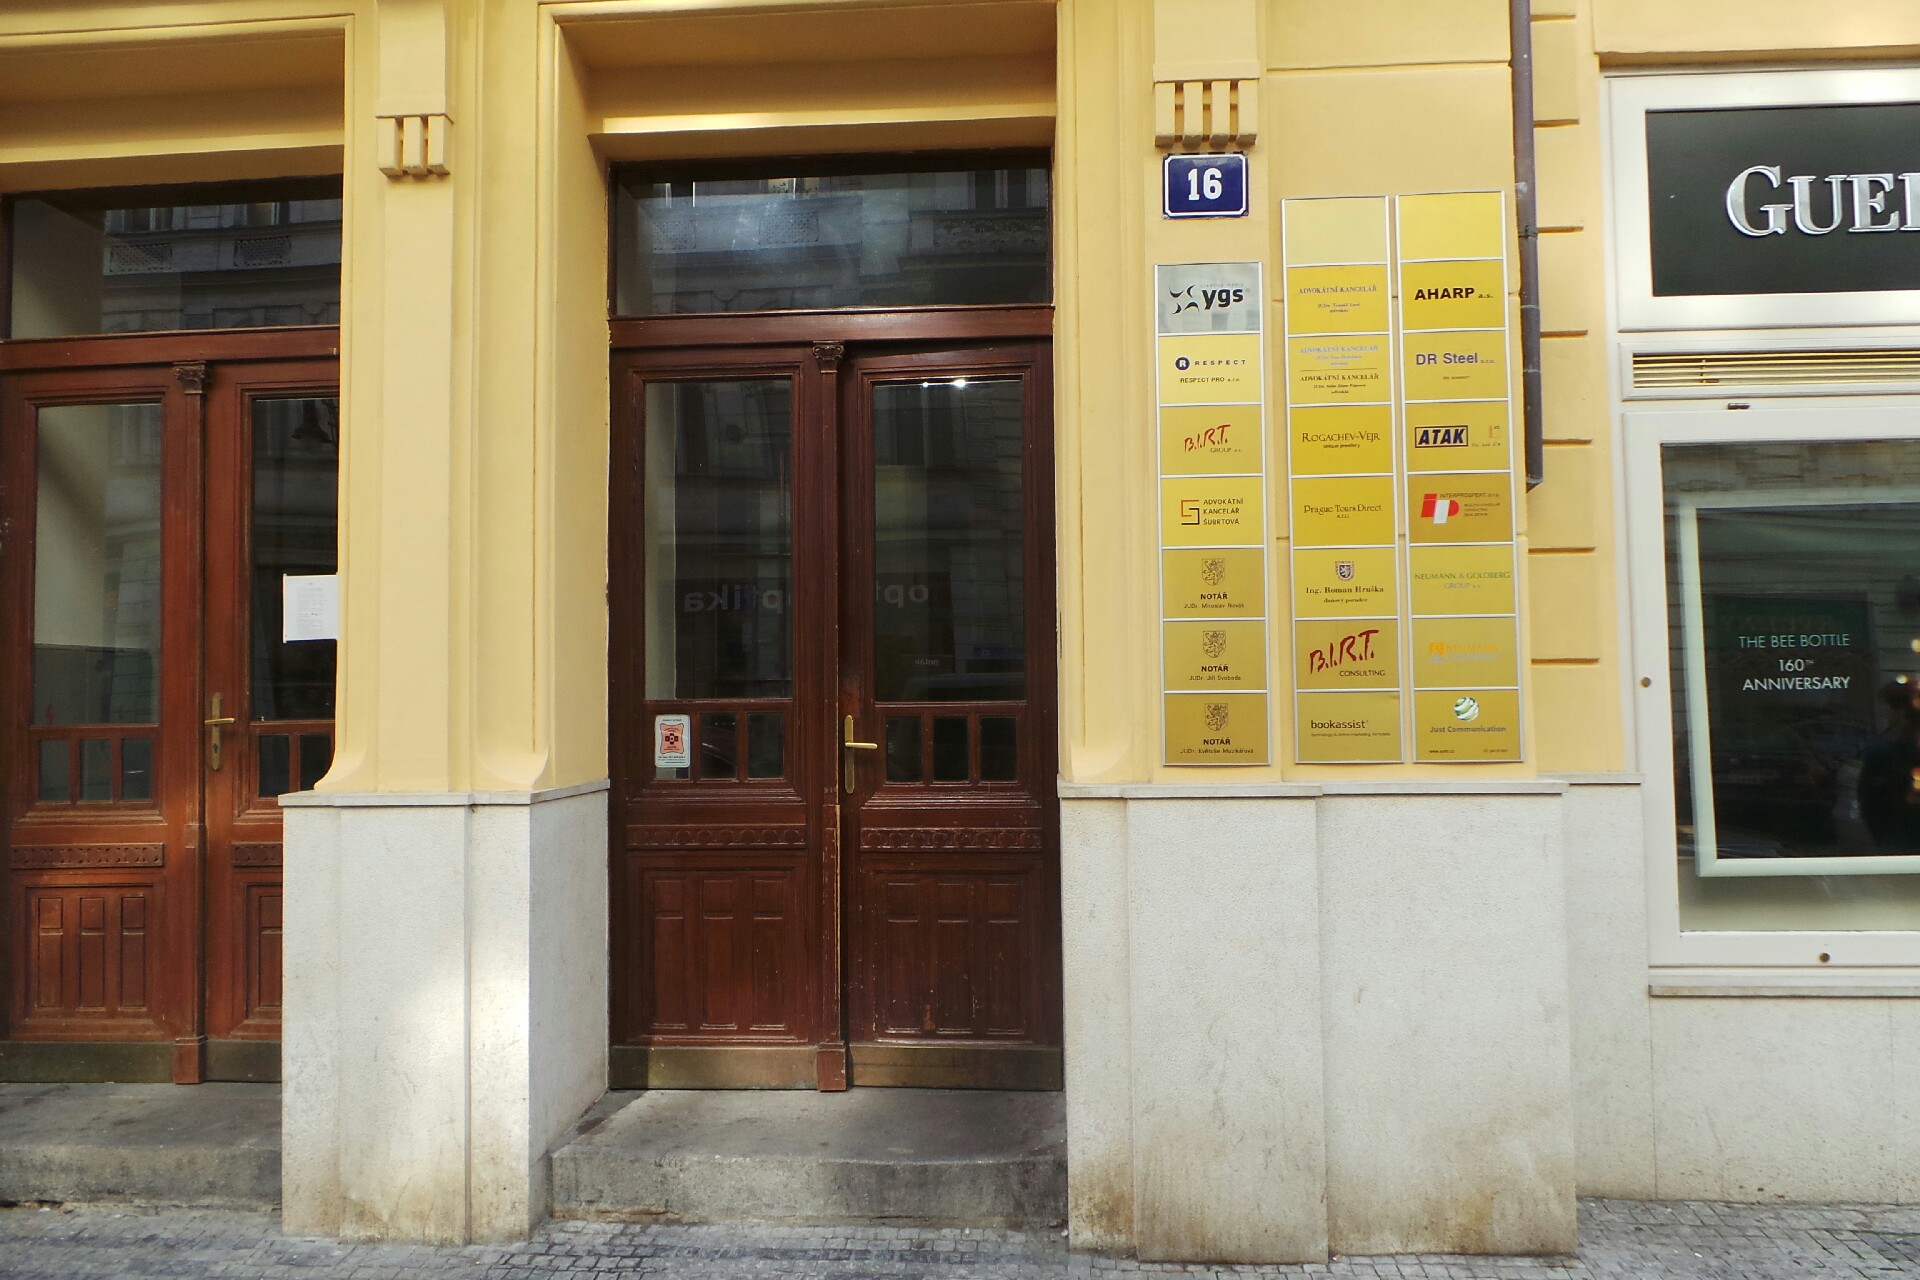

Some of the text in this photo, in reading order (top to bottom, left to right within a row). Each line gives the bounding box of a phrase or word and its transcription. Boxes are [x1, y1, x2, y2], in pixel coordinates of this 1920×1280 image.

[1188, 168, 1222, 200] 16
[1299, 286, 1338, 294] ADVOKÁTNÍ
[1414, 287, 1475, 300] AHARP
[1202, 288, 1244, 310] ygs
[1416, 353, 1437, 366] DR
[1443, 352, 1478, 364] Steel
[1184, 424, 1231, 453] B.I.R.T.
[1418, 428, 1466, 445] ATAK
[1304, 503, 1383, 515] Prague Tours Direct
[1466, 571, 1511, 579] GOLDBERG
[1200, 591, 1228, 600] NOTÁŘ
[1306, 587, 1321, 595] Ing.
[1355, 585, 1384, 593] Hruška
[1738, 633, 1850, 648] THE BEE BOTTLE
[1309, 629, 1379, 674] B.I.R.T.
[1201, 663, 1229, 672] NOTÁŘ
[1339, 669, 1386, 677] CONSULTING
[1742, 676, 1851, 691] ANNIVERSARY
[1447, 725, 1506, 733] Communication
[1203, 737, 1231, 745] NOTÁŘ
